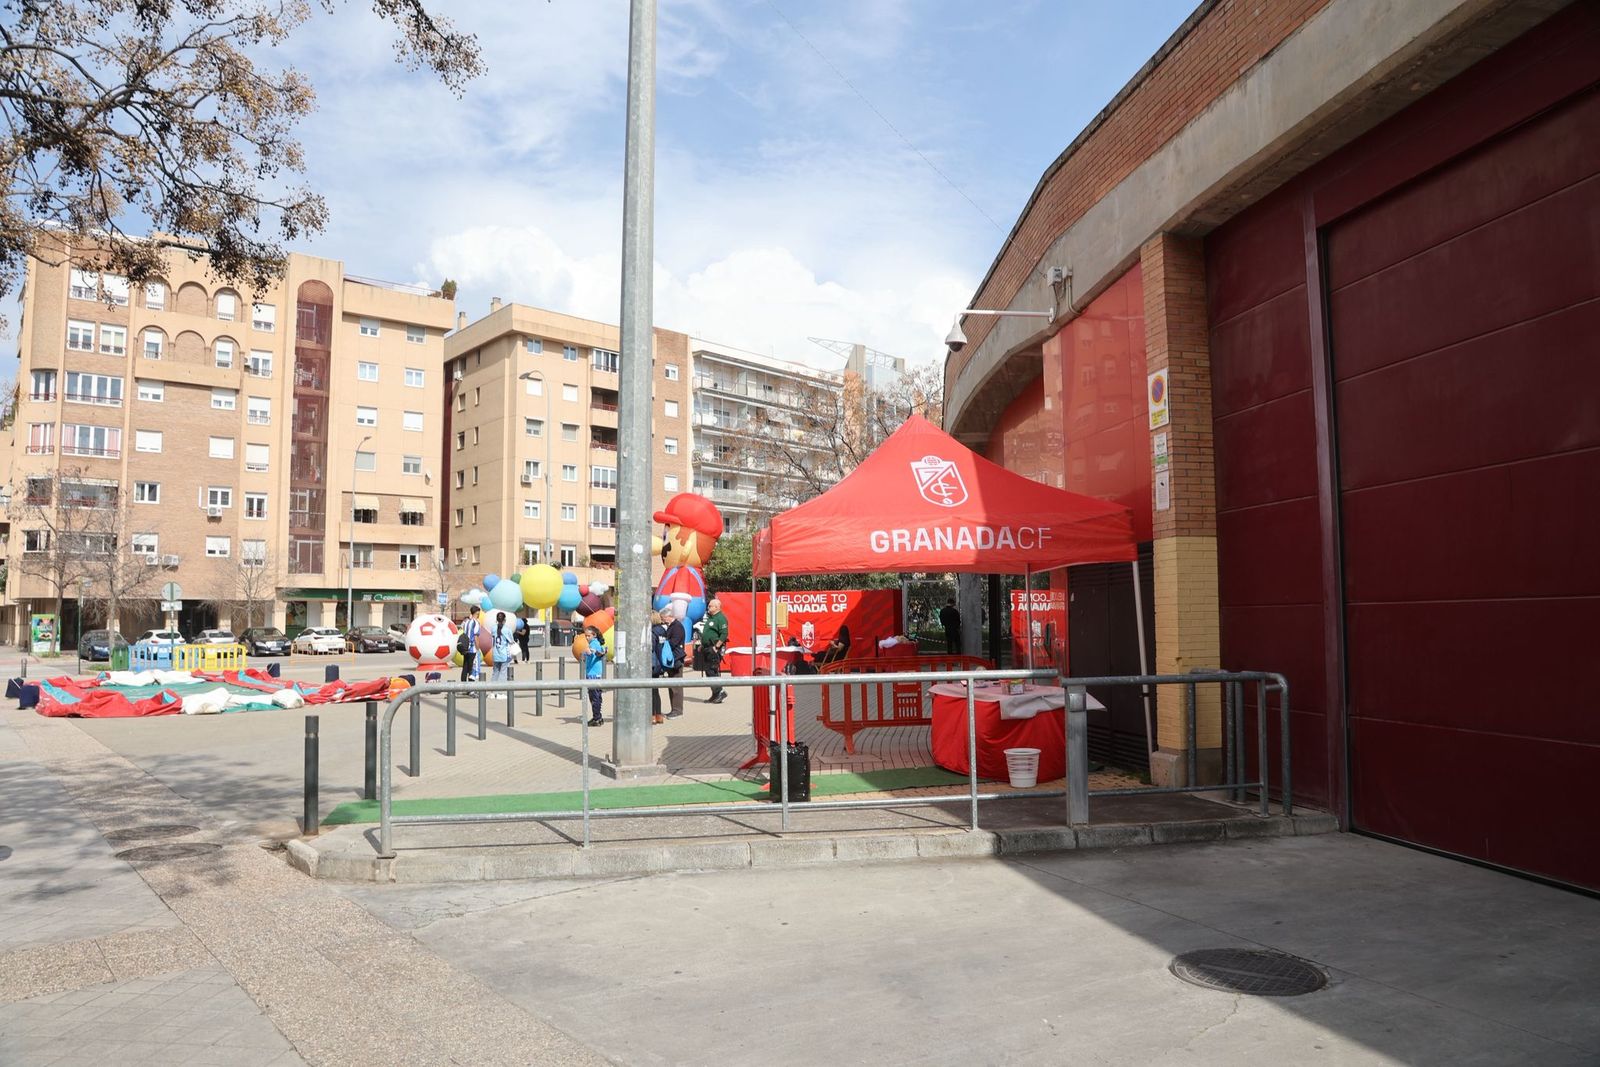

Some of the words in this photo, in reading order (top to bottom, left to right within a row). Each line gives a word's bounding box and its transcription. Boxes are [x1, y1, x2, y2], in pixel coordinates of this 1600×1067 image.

[831, 594, 847, 602] TO
[788, 604, 828, 613] ANADA
[832, 603, 847, 612] CF
